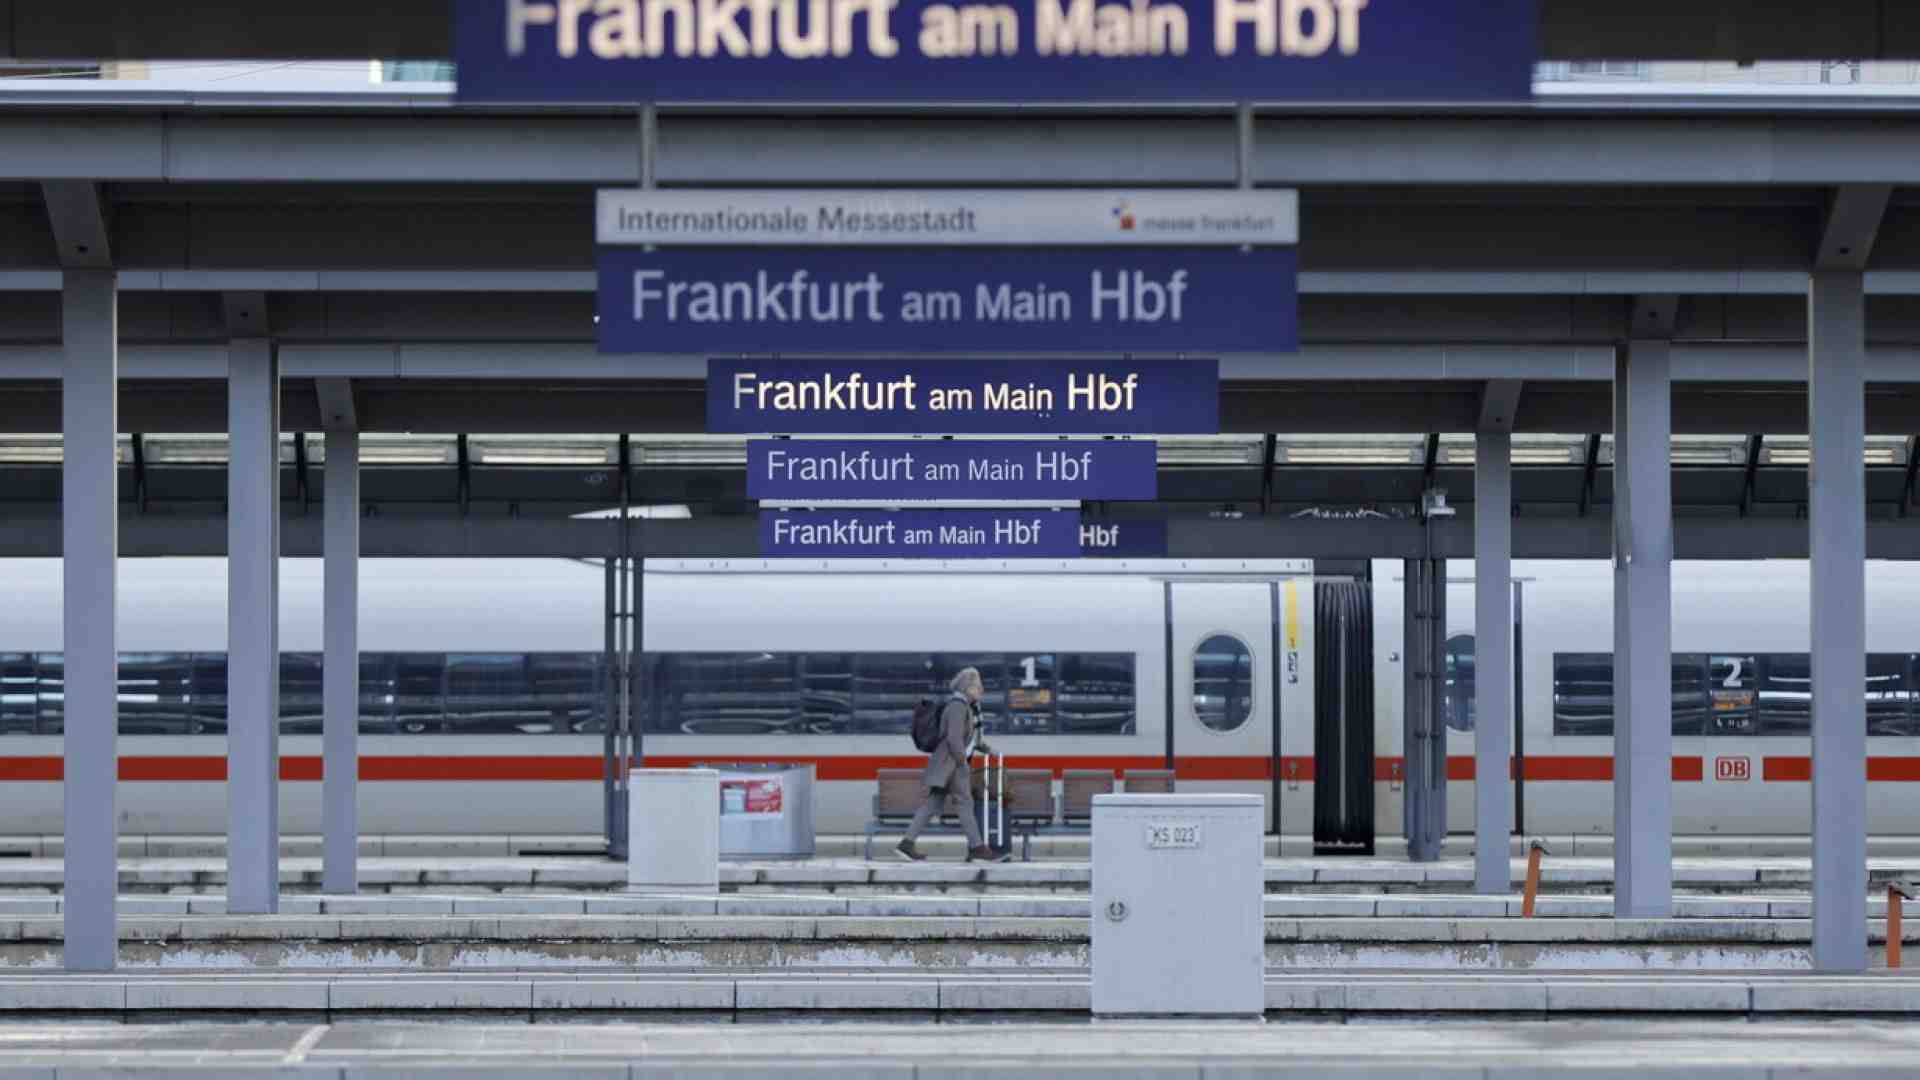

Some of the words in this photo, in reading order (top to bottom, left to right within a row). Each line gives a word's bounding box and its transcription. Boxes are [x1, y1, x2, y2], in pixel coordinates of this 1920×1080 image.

[509, 0, 898, 58] Frankfurt
[918, 4, 1019, 57] am
[1035, 0, 1189, 57] Main
[1213, 0, 1368, 57] Hbf
[618, 206, 808, 233] Internationale
[818, 206, 977, 233] Messestadt
[633, 269, 884, 322] Frankfurt
[901, 291, 962, 322] am
[975, 283, 1071, 322] Main
[1091, 269, 1187, 322] Hbf
[734, 373, 917, 411] Frankfurt
[928, 388, 973, 411] am
[983, 382, 1053, 411] Main
[1068, 373, 1138, 411] Hbf
[767, 451, 914, 481] Frankfurt
[924, 463, 959, 481] am
[968, 458, 1023, 481] Main
[1036, 451, 1092, 481] Hbf
[774, 519, 895, 545] Frankfurt
[904, 529, 933, 545] am
[940, 526, 986, 545] Main
[995, 519, 1041, 545] Hbf
[1080, 525, 1118, 547] Hbf
[1020, 656, 1039, 687] 1
[1722, 657, 1742, 687] 2
[1719, 760, 1748, 778] DB
